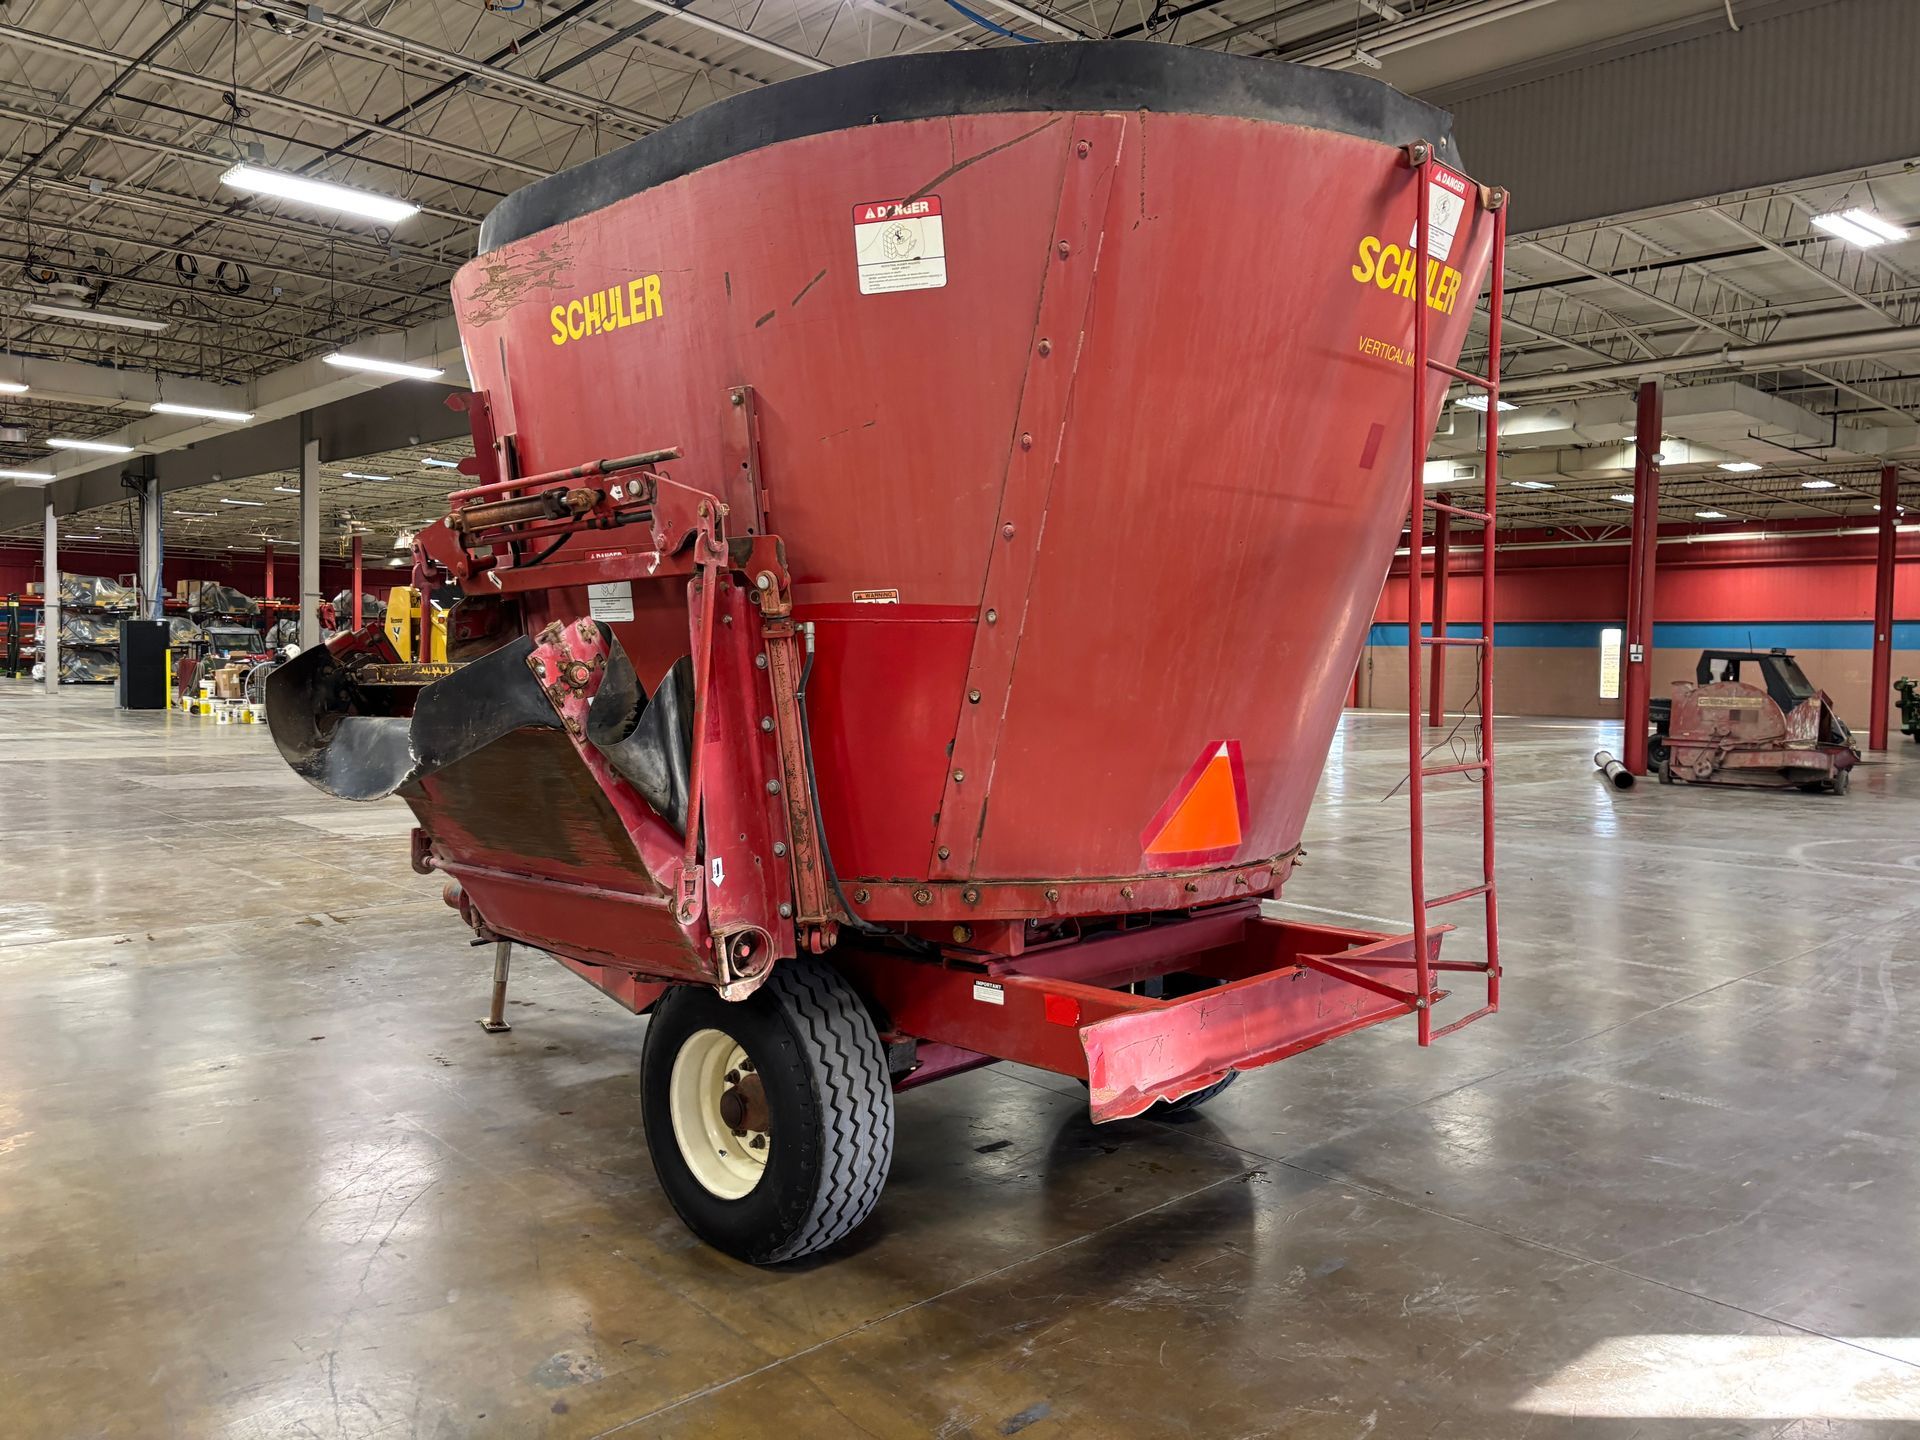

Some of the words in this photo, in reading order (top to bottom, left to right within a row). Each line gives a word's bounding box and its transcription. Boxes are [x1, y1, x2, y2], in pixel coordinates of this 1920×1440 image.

[1442, 173, 1465, 194] DANGER
[550, 274, 663, 346] SCHULER
[1358, 336, 1404, 365] VERTICAL
[975, 980, 1002, 990] IMPORTANT
